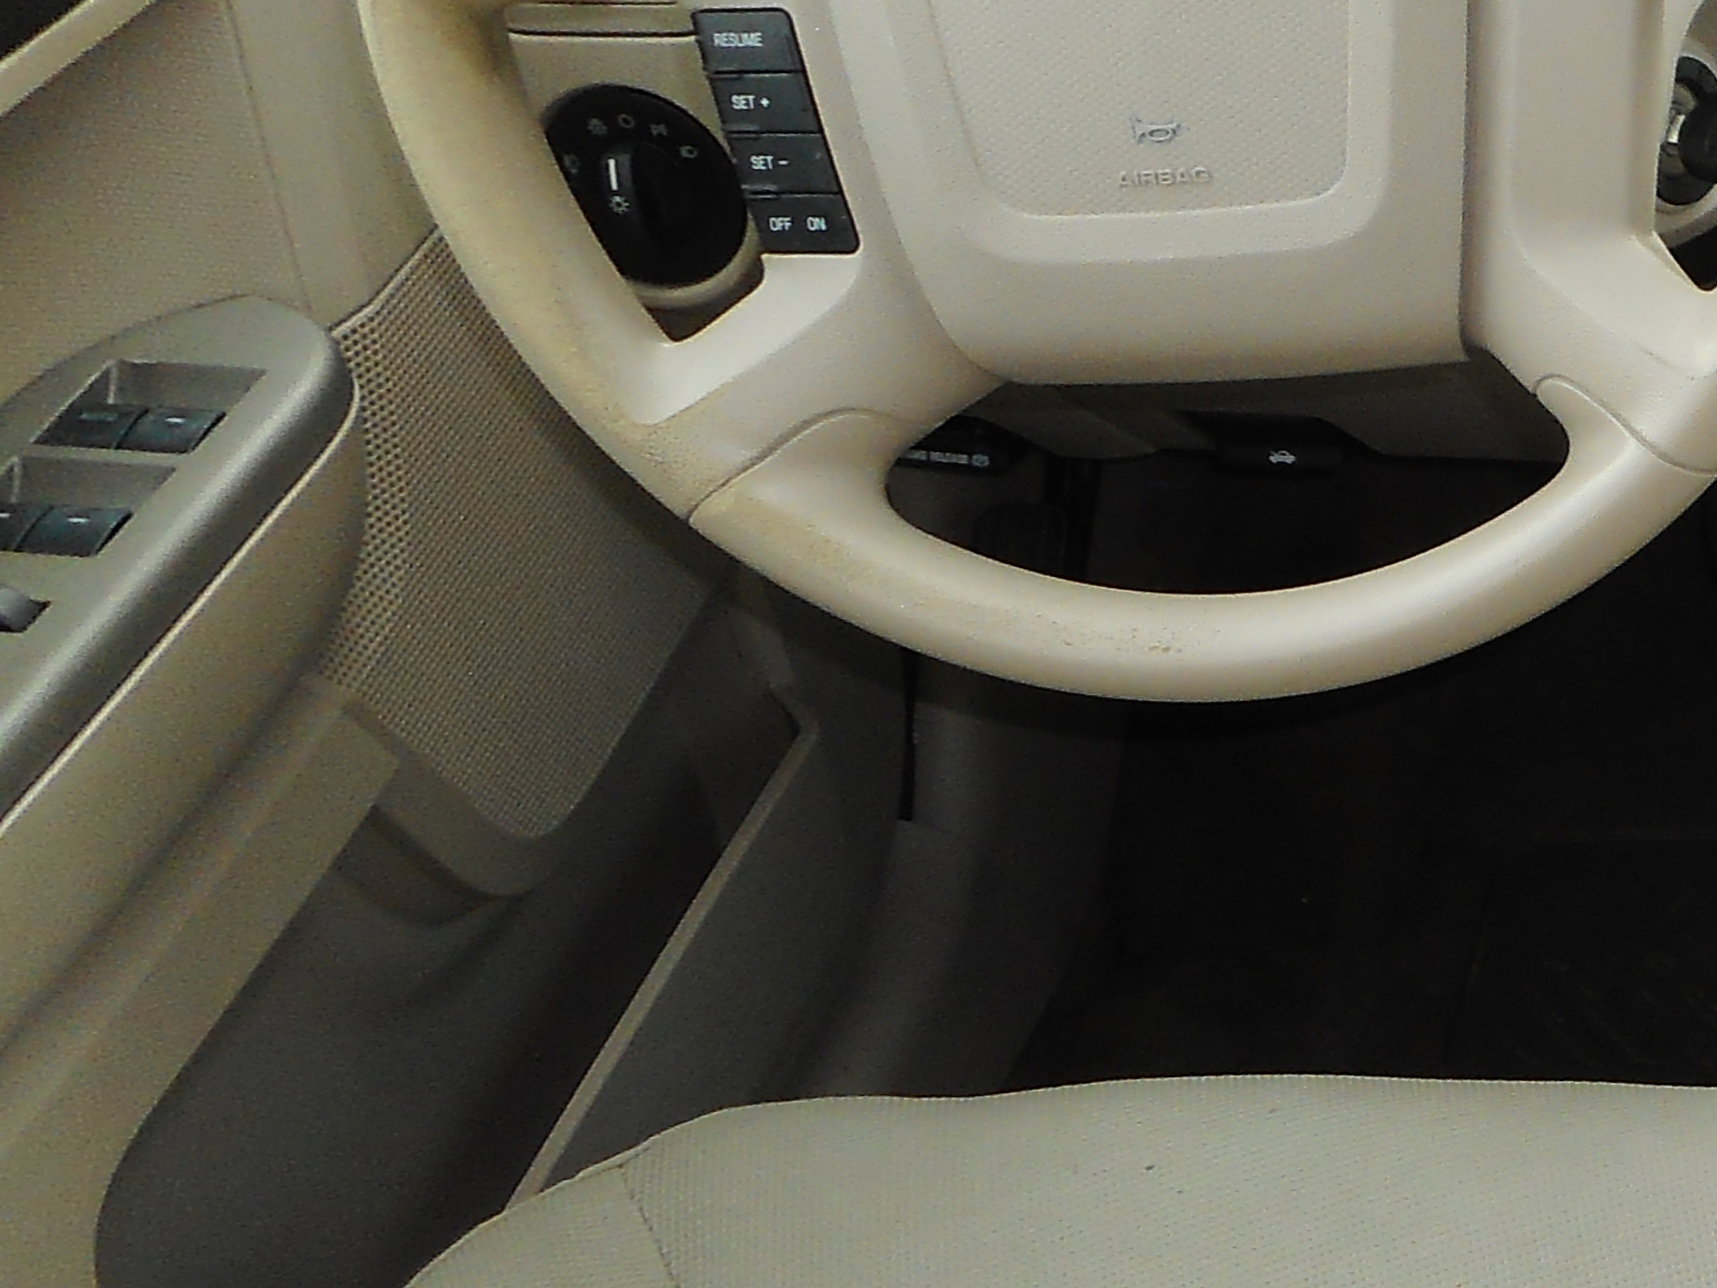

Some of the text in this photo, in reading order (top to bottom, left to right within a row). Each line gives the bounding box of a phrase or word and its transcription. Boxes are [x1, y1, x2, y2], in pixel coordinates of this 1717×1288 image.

[713, 32, 764, 48] RESUME
[731, 94, 755, 110] SET
[750, 155, 774, 170] SET
[1119, 166, 1212, 187] AIRBAG
[769, 217, 792, 232] OFF
[806, 217, 828, 232] ON
